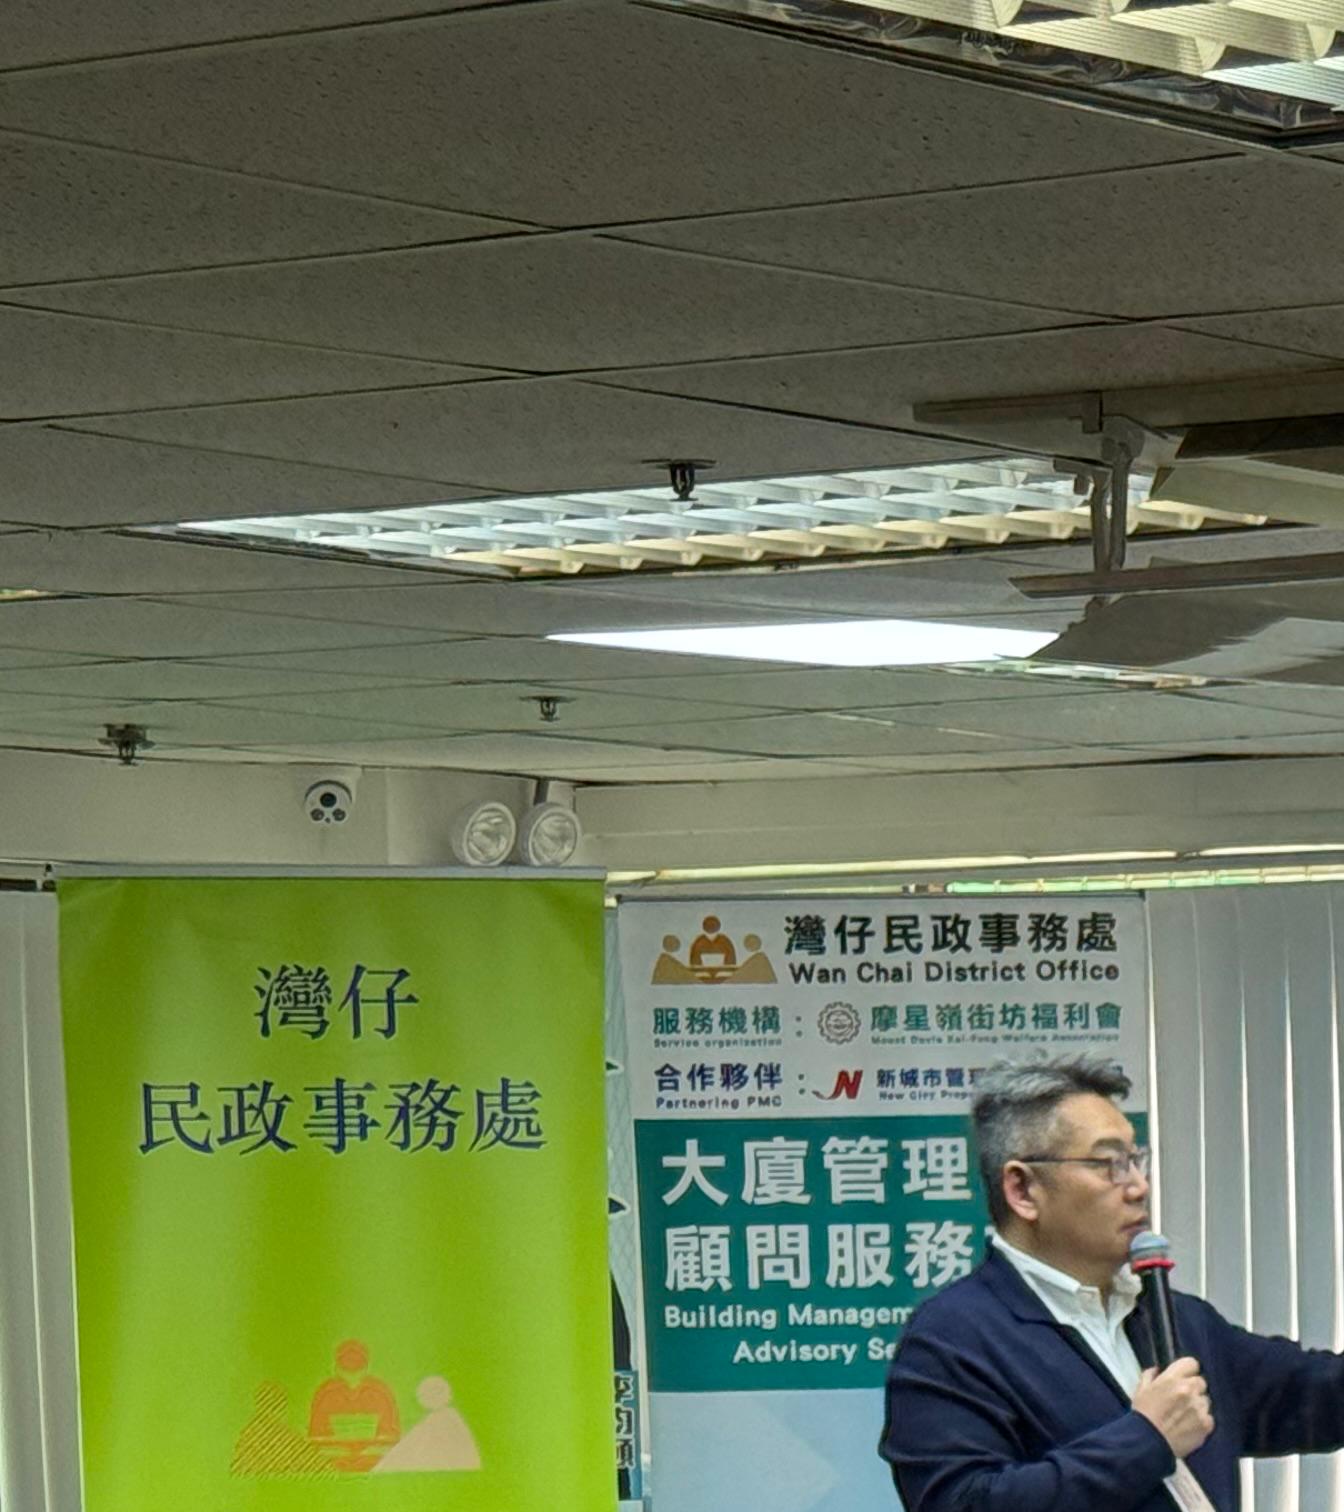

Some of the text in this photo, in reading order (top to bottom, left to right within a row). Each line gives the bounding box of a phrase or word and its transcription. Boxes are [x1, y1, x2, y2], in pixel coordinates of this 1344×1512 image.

[784, 912, 1118, 956] 灣仔民政事務處
[789, 960, 1120, 985] Wan Chai District Office
[254, 964, 420, 1039] 灣仔
[870, 1002, 1121, 1032] 摩星嶺街坊福利會
[654, 1037, 782, 1049] Service organization
[139, 1077, 548, 1155] 民政事務處
[656, 1095, 782, 1110] Partnering PMC
[662, 1136, 973, 1206] 大廈管理
[664, 1304, 914, 1330] Building Managem
[733, 1340, 857, 1365] Advisory
